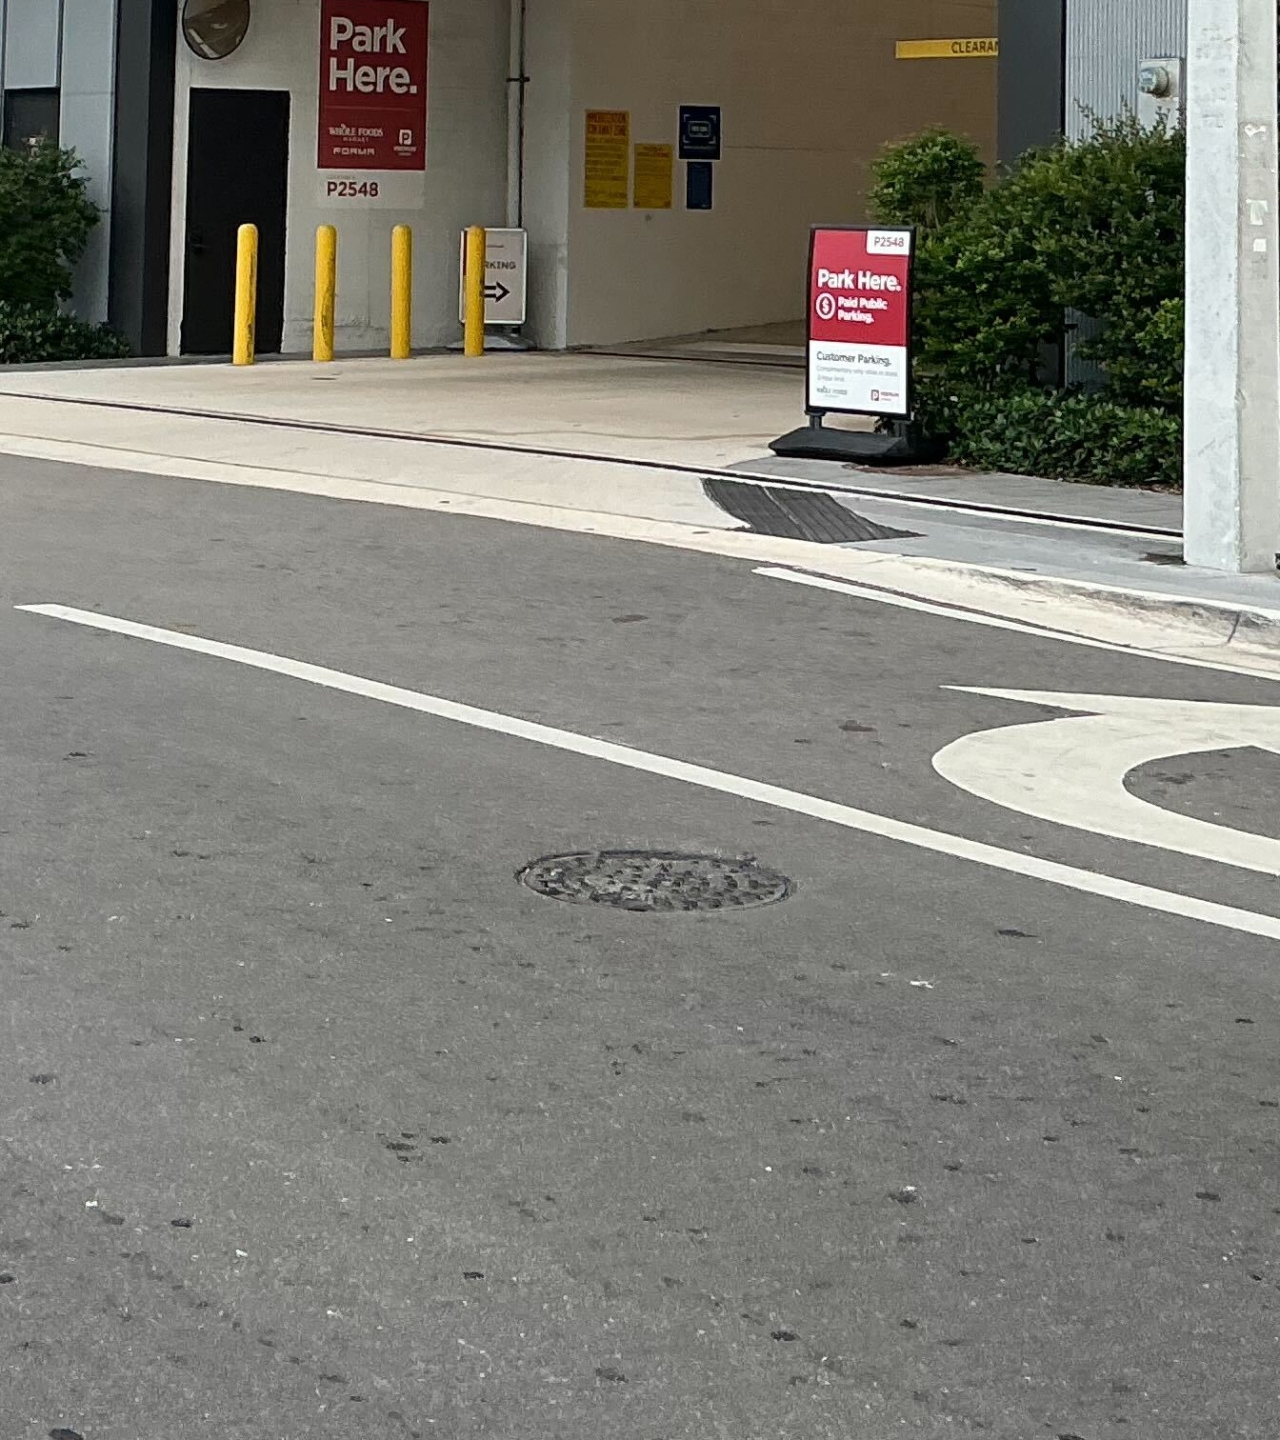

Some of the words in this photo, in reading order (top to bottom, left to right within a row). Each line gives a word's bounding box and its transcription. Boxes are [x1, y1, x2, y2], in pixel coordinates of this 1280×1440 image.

[330, 16, 406, 54] Park
[329, 57, 417, 94] Here.
[327, 181, 378, 197] P2548
[874, 236, 905, 247] P2548
[484, 260, 517, 270] RKING
[817, 268, 855, 289] Park
[857, 270, 902, 292] Here.
[837, 296, 858, 308] Paid
[859, 297, 889, 310] Public
[816, 351, 856, 363] Customer
